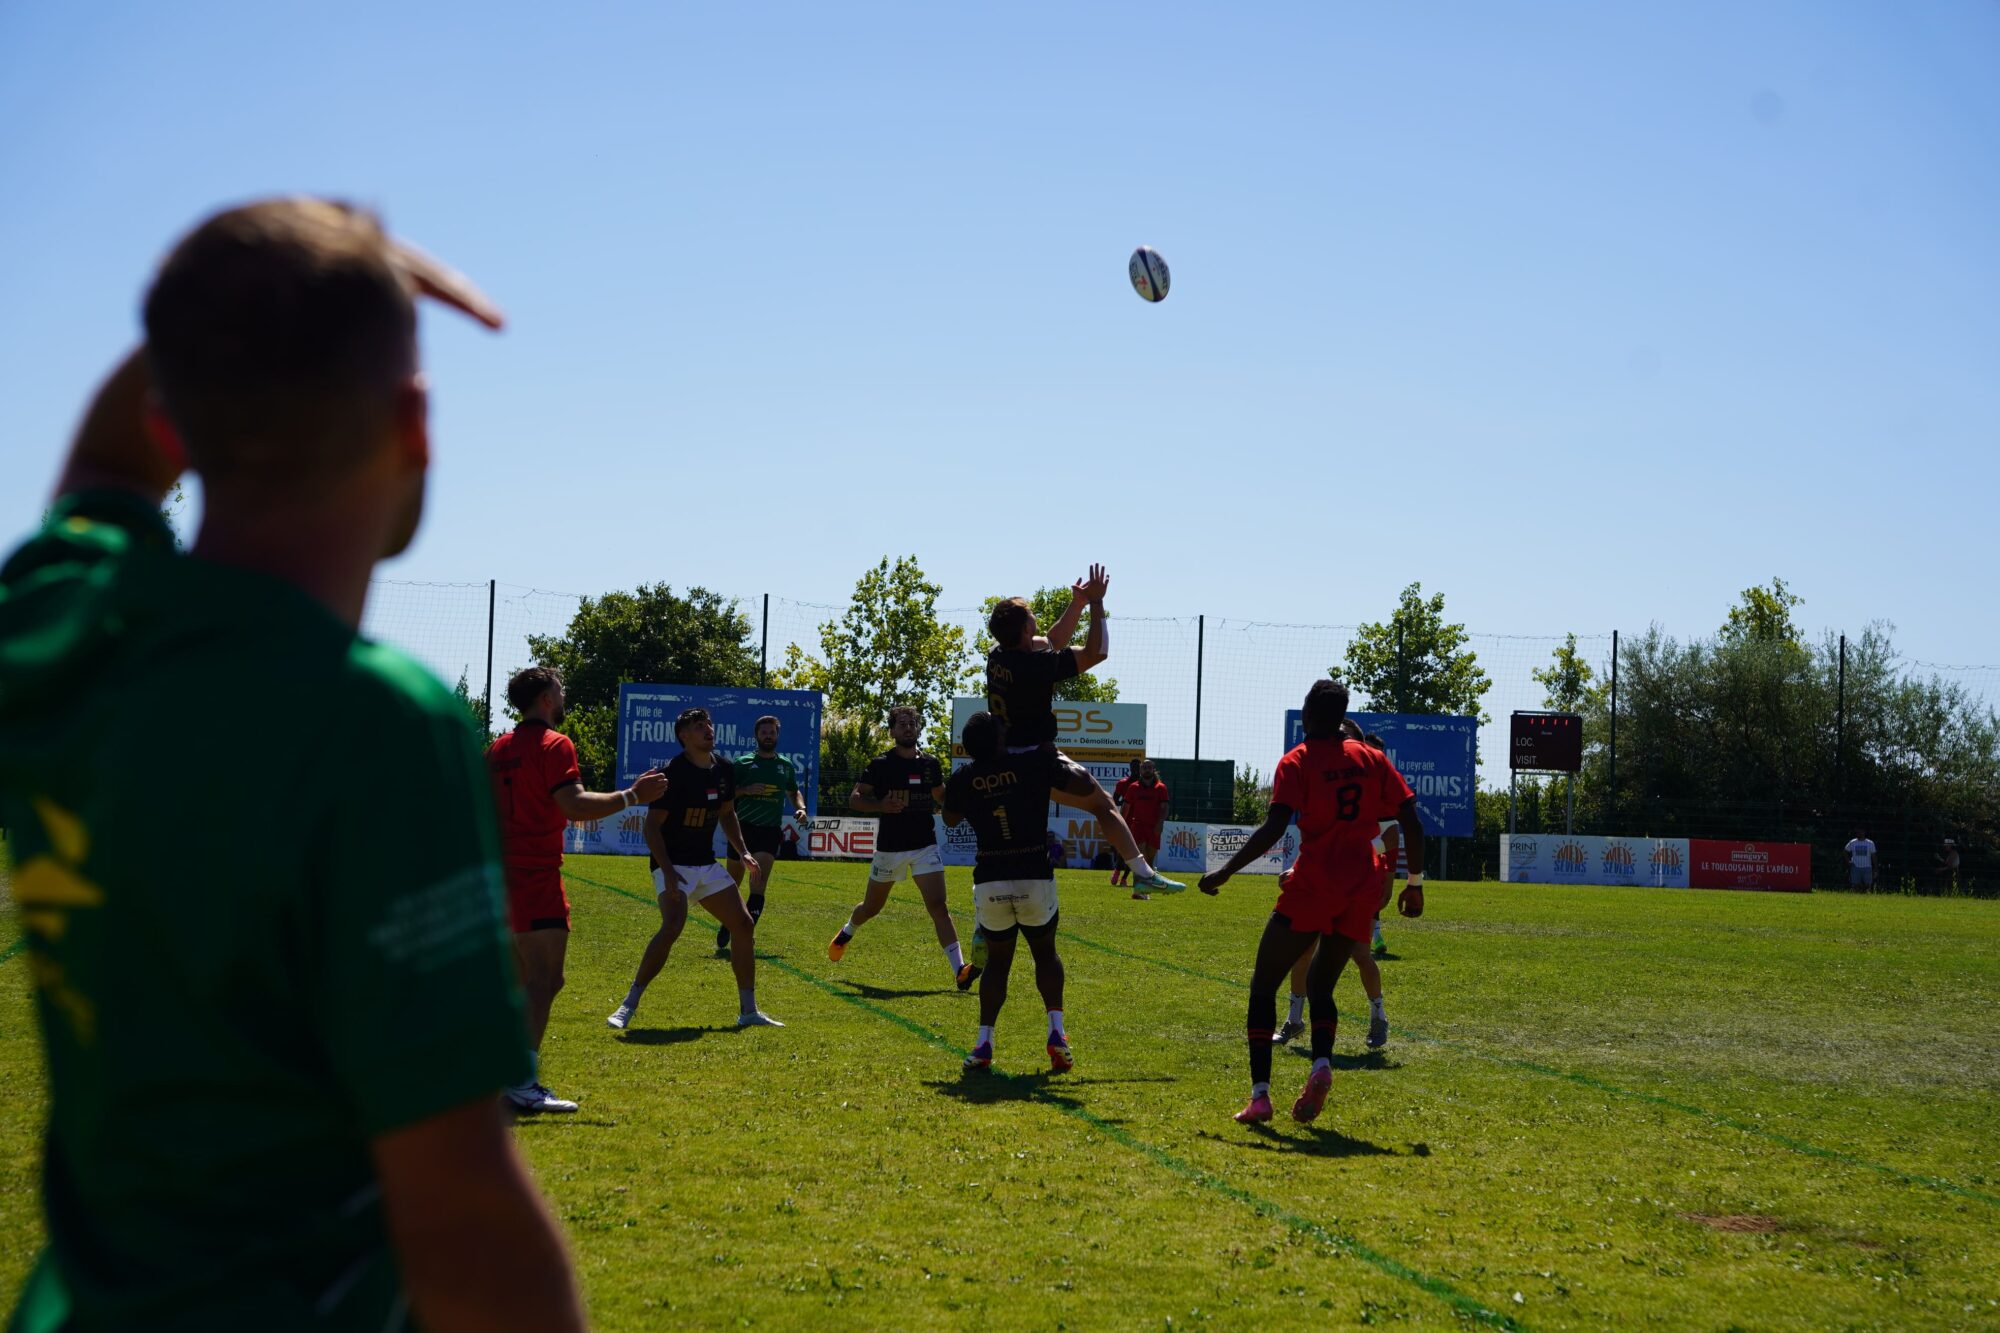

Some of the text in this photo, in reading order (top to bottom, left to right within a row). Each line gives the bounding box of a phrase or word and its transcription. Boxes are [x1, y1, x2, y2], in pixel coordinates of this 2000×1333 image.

[635, 706, 663, 718] Ville de
[1052, 709, 1112, 733] BS
[632, 720, 737, 746] FRONAN
[1398, 759, 1435, 772] la peyrade
[972, 770, 1018, 793] apm
[1403, 774, 1462, 797] PIONS
[1337, 784, 1361, 820] 8
[992, 804, 1013, 840] 1
[808, 832, 874, 854] ONE
[1211, 834, 1250, 845] SEVENS
[1168, 845, 1200, 859] SEVENS
[1733, 852, 1767, 862] menguy's
[1553, 859, 1587, 873] SEVENS
[1603, 861, 1635, 875] SEVENS
[1650, 862, 1683, 876] SEVENS
[1701, 862, 1710, 870] LE
[1712, 862, 1754, 872] TOULOUSAIN
[1756, 865, 1765, 873] DE
[1767, 865, 1794, 873] L'APÉRO
